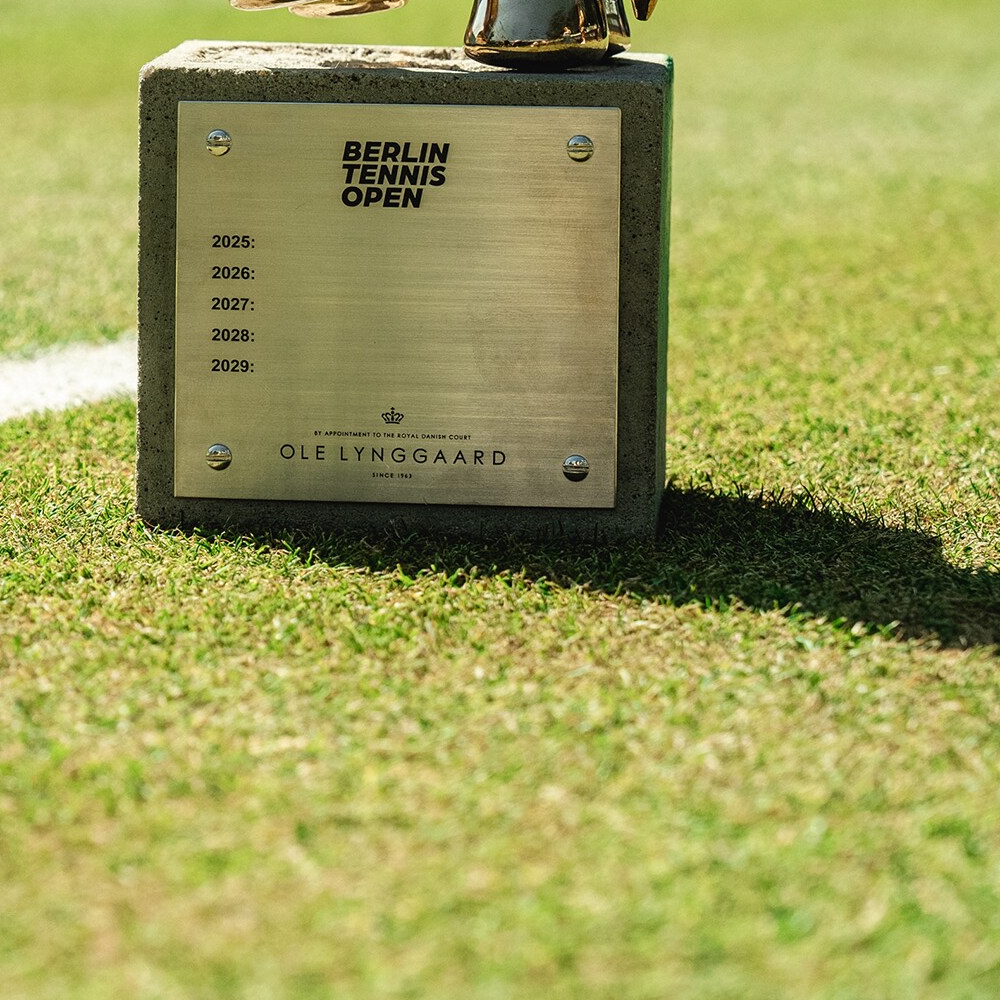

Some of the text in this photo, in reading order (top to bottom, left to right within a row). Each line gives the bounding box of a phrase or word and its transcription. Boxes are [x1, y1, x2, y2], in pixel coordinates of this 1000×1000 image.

[342, 141, 450, 164] BERLIN
[342, 164, 446, 187] TENNIS
[341, 187, 423, 209] OPEN
[211, 234, 255, 249] 2025:
[211, 265, 255, 280] 2026:
[211, 296, 255, 311] 2027:
[211, 327, 255, 342] 2028:
[211, 358, 255, 373] 2029:
[324, 430, 370, 438] APPOINTMENT
[372, 431, 382, 439] TO
[397, 432, 419, 440] ROYAL
[280, 443, 506, 466] OLE LYNGGAARD
